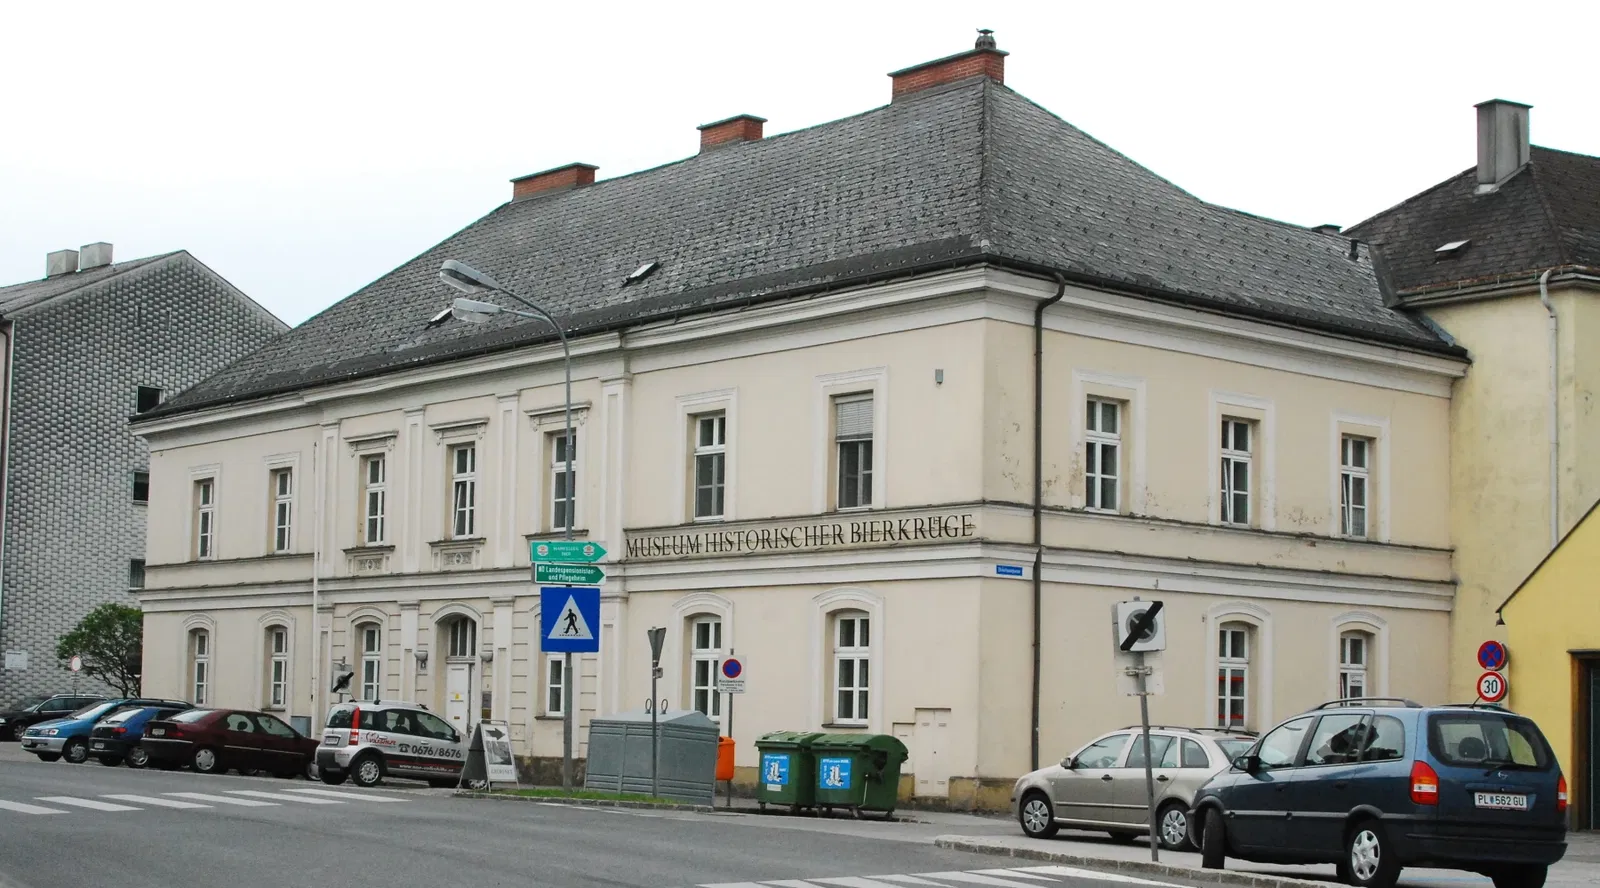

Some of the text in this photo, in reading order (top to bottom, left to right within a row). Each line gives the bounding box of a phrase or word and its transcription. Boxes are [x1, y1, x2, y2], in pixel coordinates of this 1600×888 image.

[625, 534, 700, 558] MUSEUM
[705, 523, 845, 553] HISTORISCHER
[548, 573, 587, 582] und Pflegeheim
[1483, 679, 1498, 694] 30
[411, 744, 462, 759] 0676/8676
[1478, 794, 1524, 807] PL 562 GU
